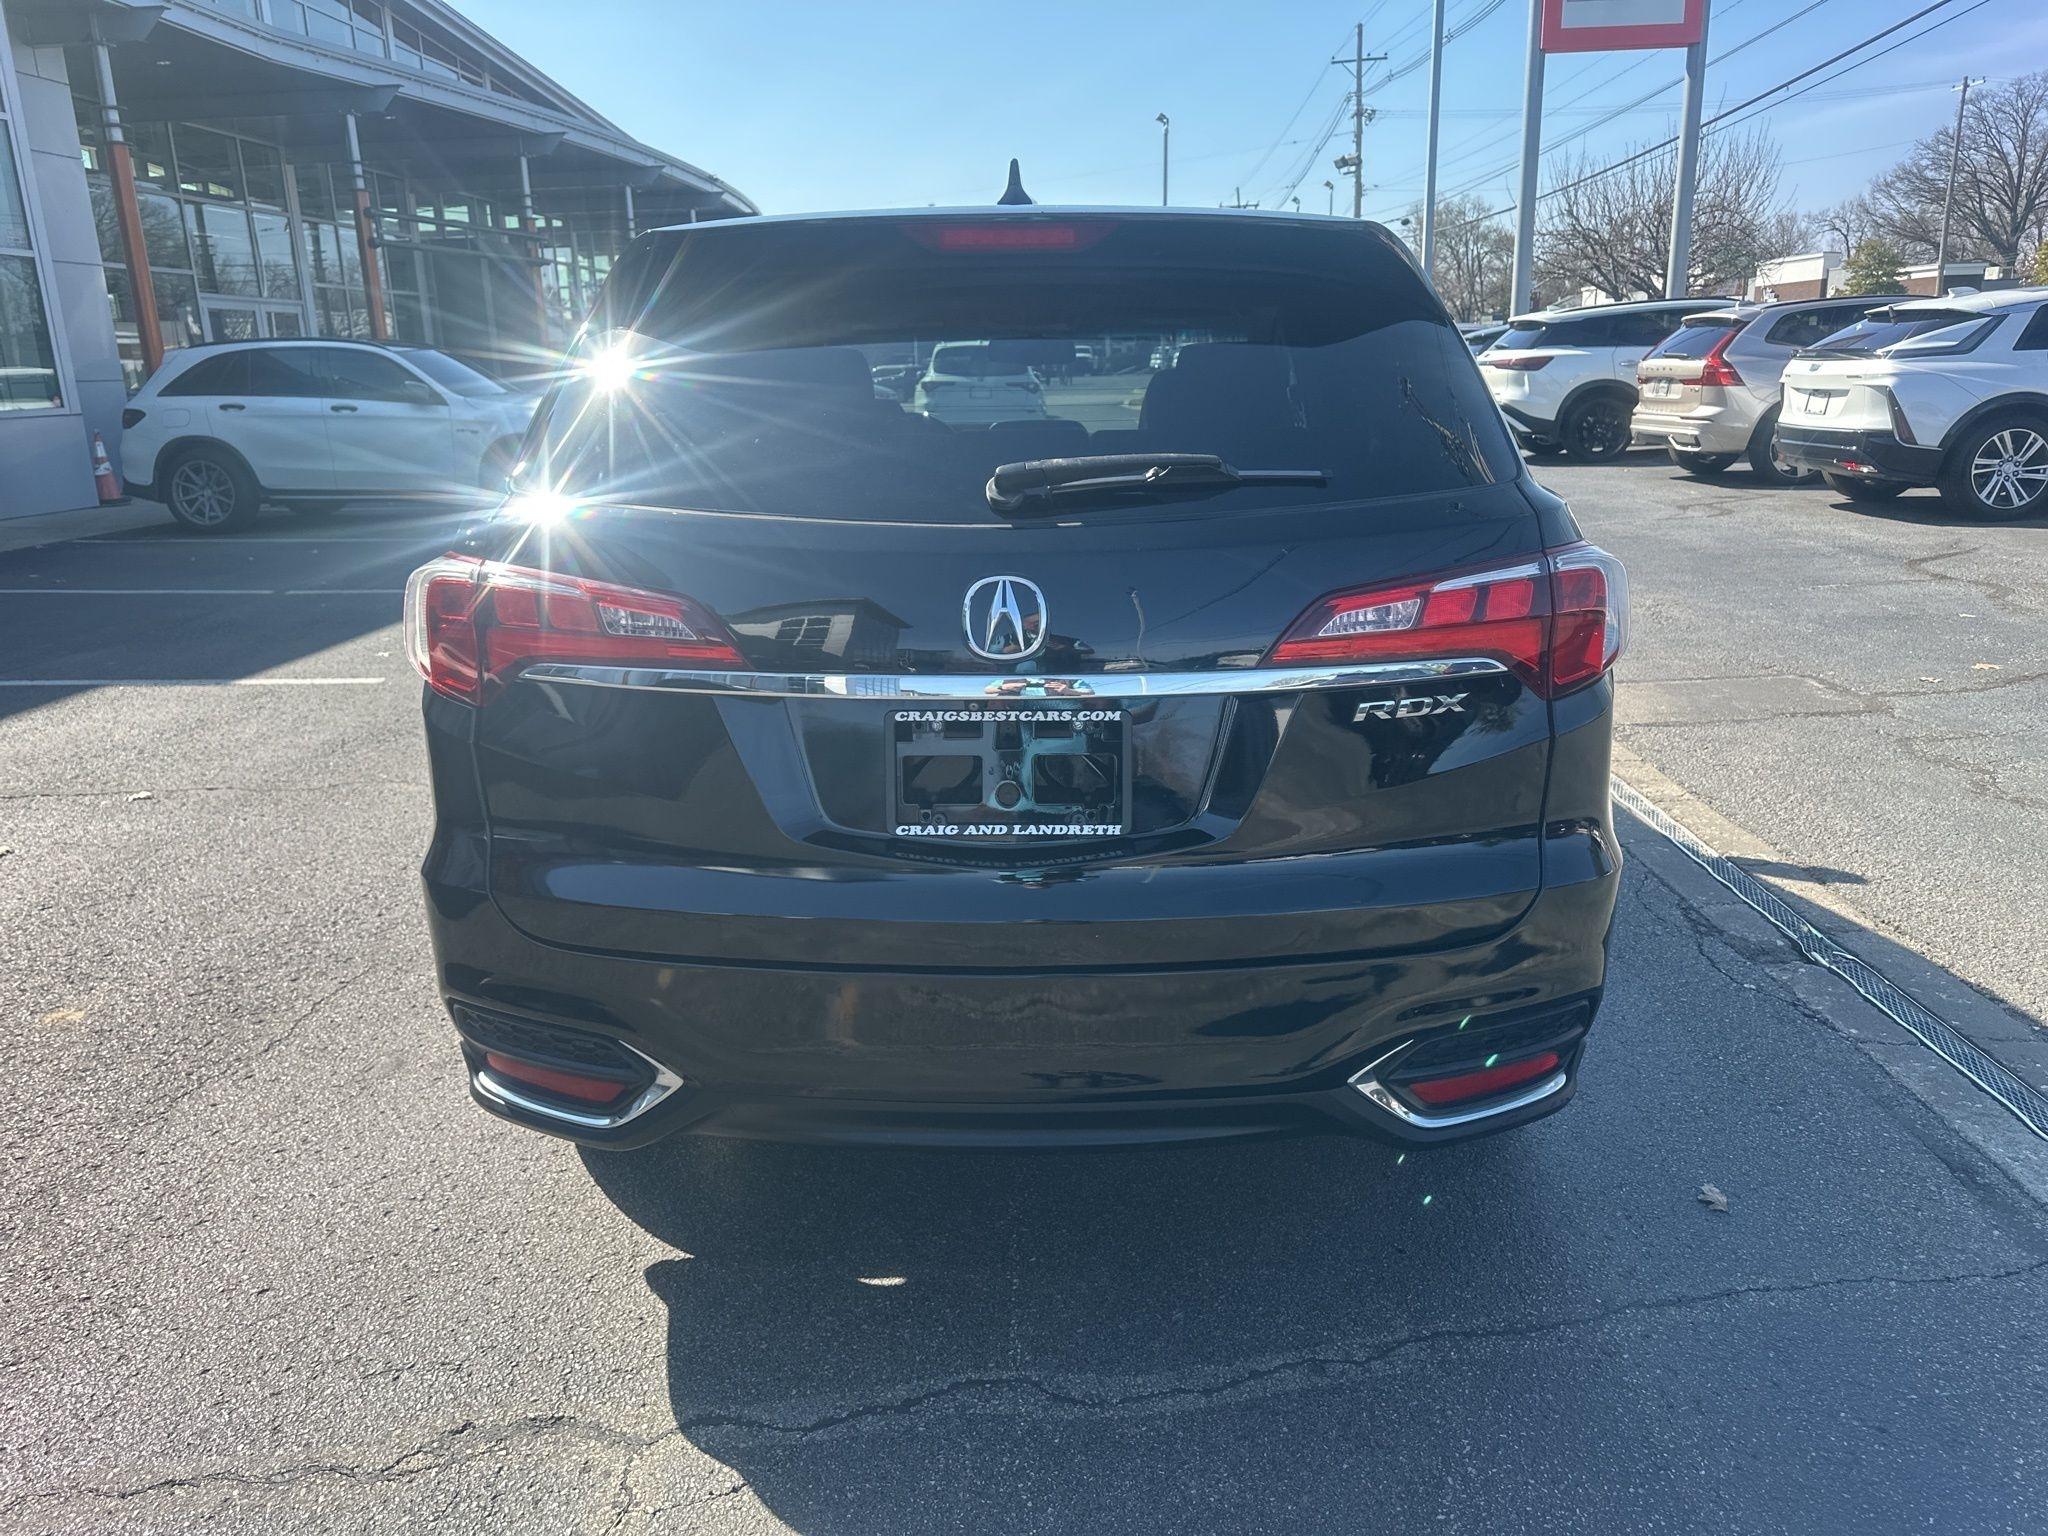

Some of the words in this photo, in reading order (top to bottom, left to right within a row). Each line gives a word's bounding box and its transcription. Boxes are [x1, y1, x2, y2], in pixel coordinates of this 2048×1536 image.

[1353, 692, 1470, 722] RDX
[894, 710, 1122, 722] CRAIGSBESTCARS.COM
[895, 825, 959, 836] CRAIG
[963, 824, 1008, 835] AND
[1012, 824, 1122, 836] LANDRETH
